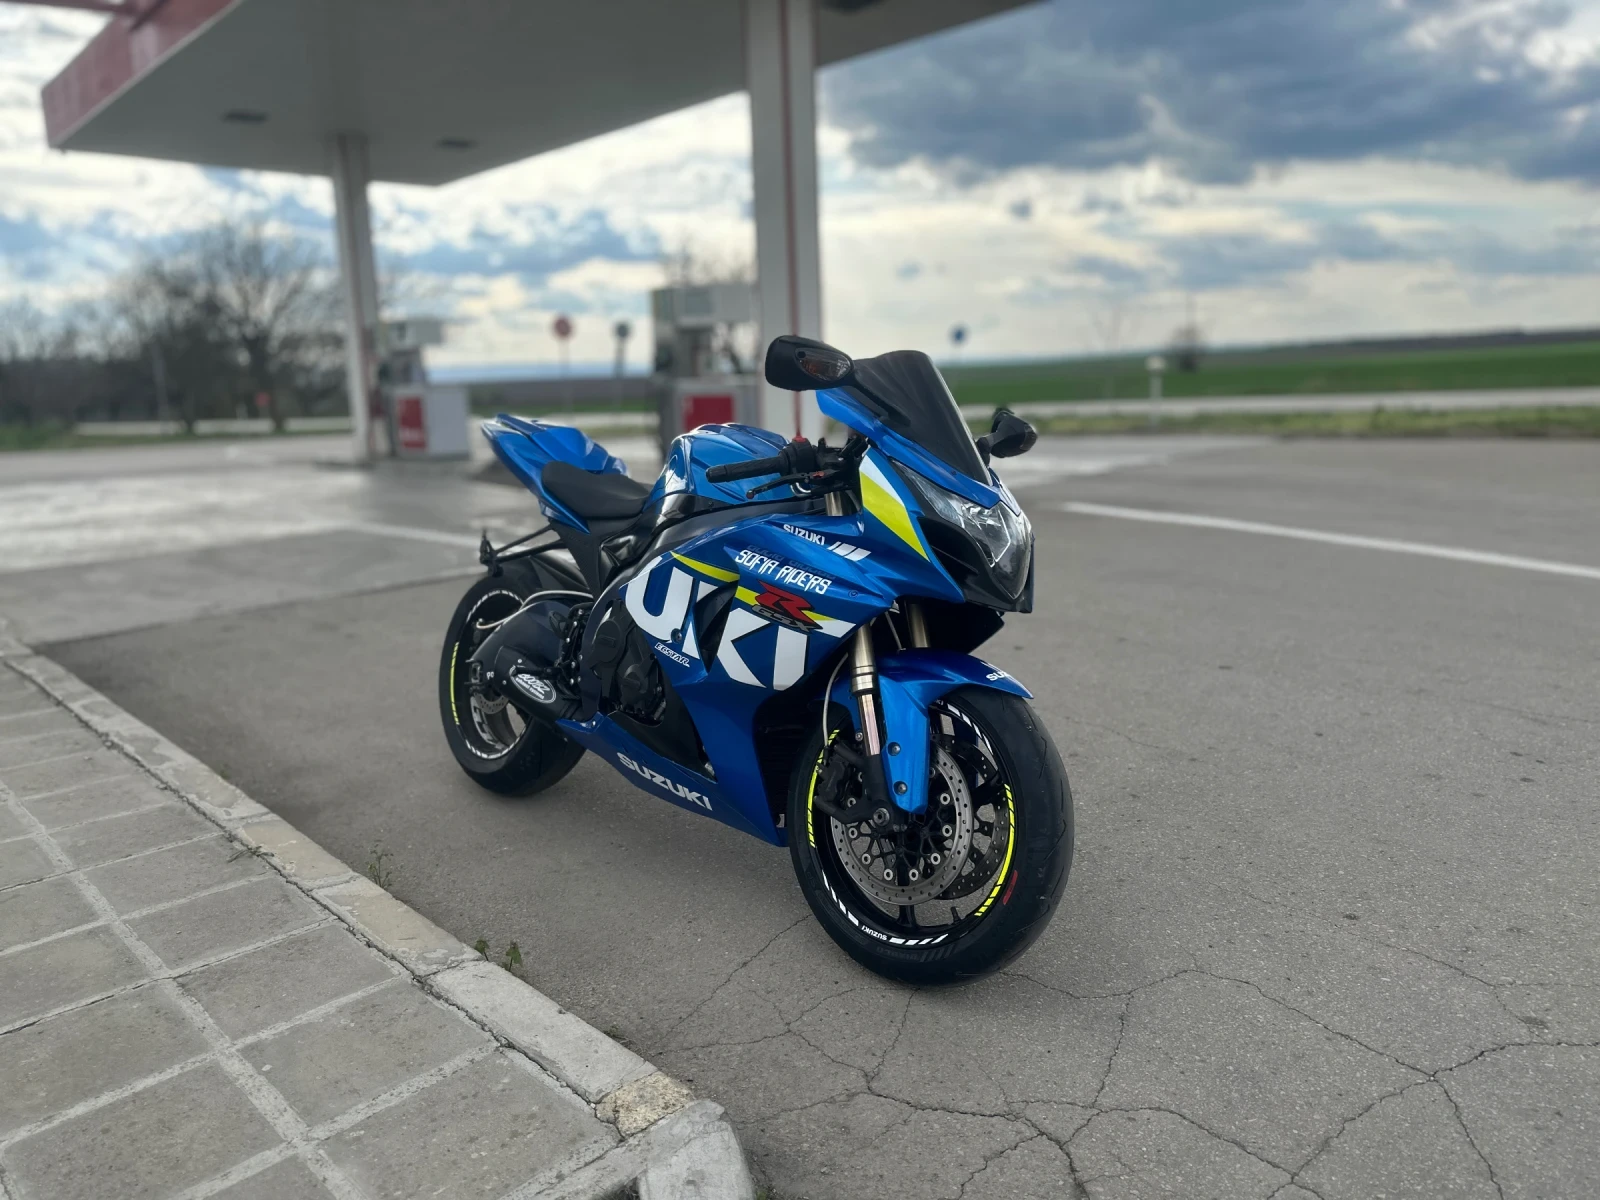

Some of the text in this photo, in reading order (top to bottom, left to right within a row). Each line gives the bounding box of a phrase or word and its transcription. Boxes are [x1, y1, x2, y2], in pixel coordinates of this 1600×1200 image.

[783, 524, 826, 546] SUZUKI
[735, 549, 779, 574] SOFIA
[774, 565, 832, 595] RIDERS
[654, 642, 691, 668] ECSTAR
[617, 752, 714, 812] SUZUKI
[861, 925, 888, 941] SUZUKI
